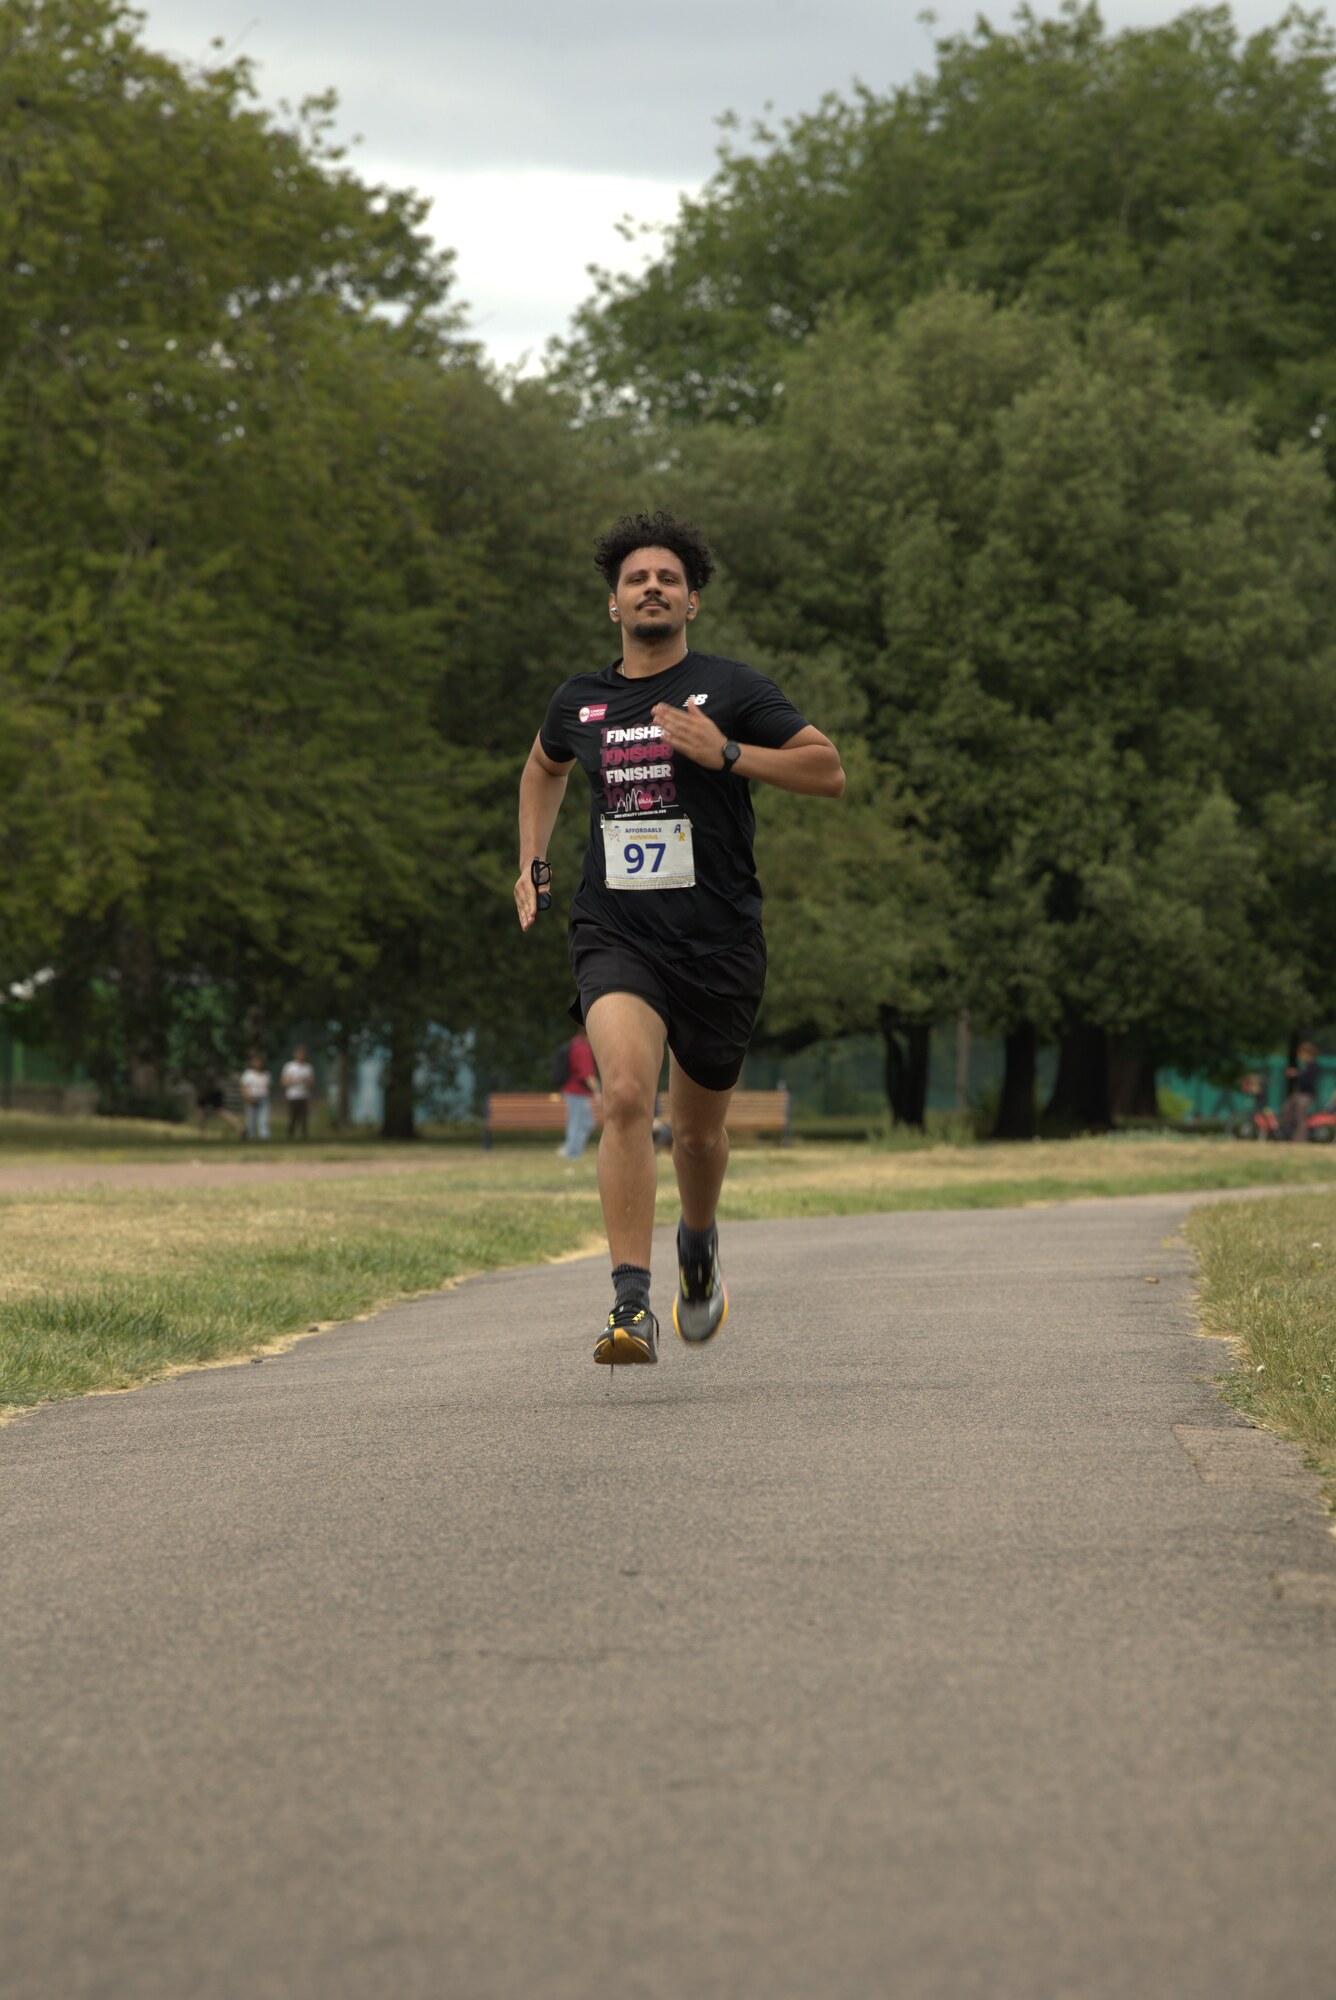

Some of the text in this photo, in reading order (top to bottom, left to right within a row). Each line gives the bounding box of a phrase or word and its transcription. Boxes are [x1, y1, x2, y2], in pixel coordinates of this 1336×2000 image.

[605, 744, 671, 763] FINISHER
[606, 764, 672, 784] FINISHER
[624, 843, 666, 873] 97
